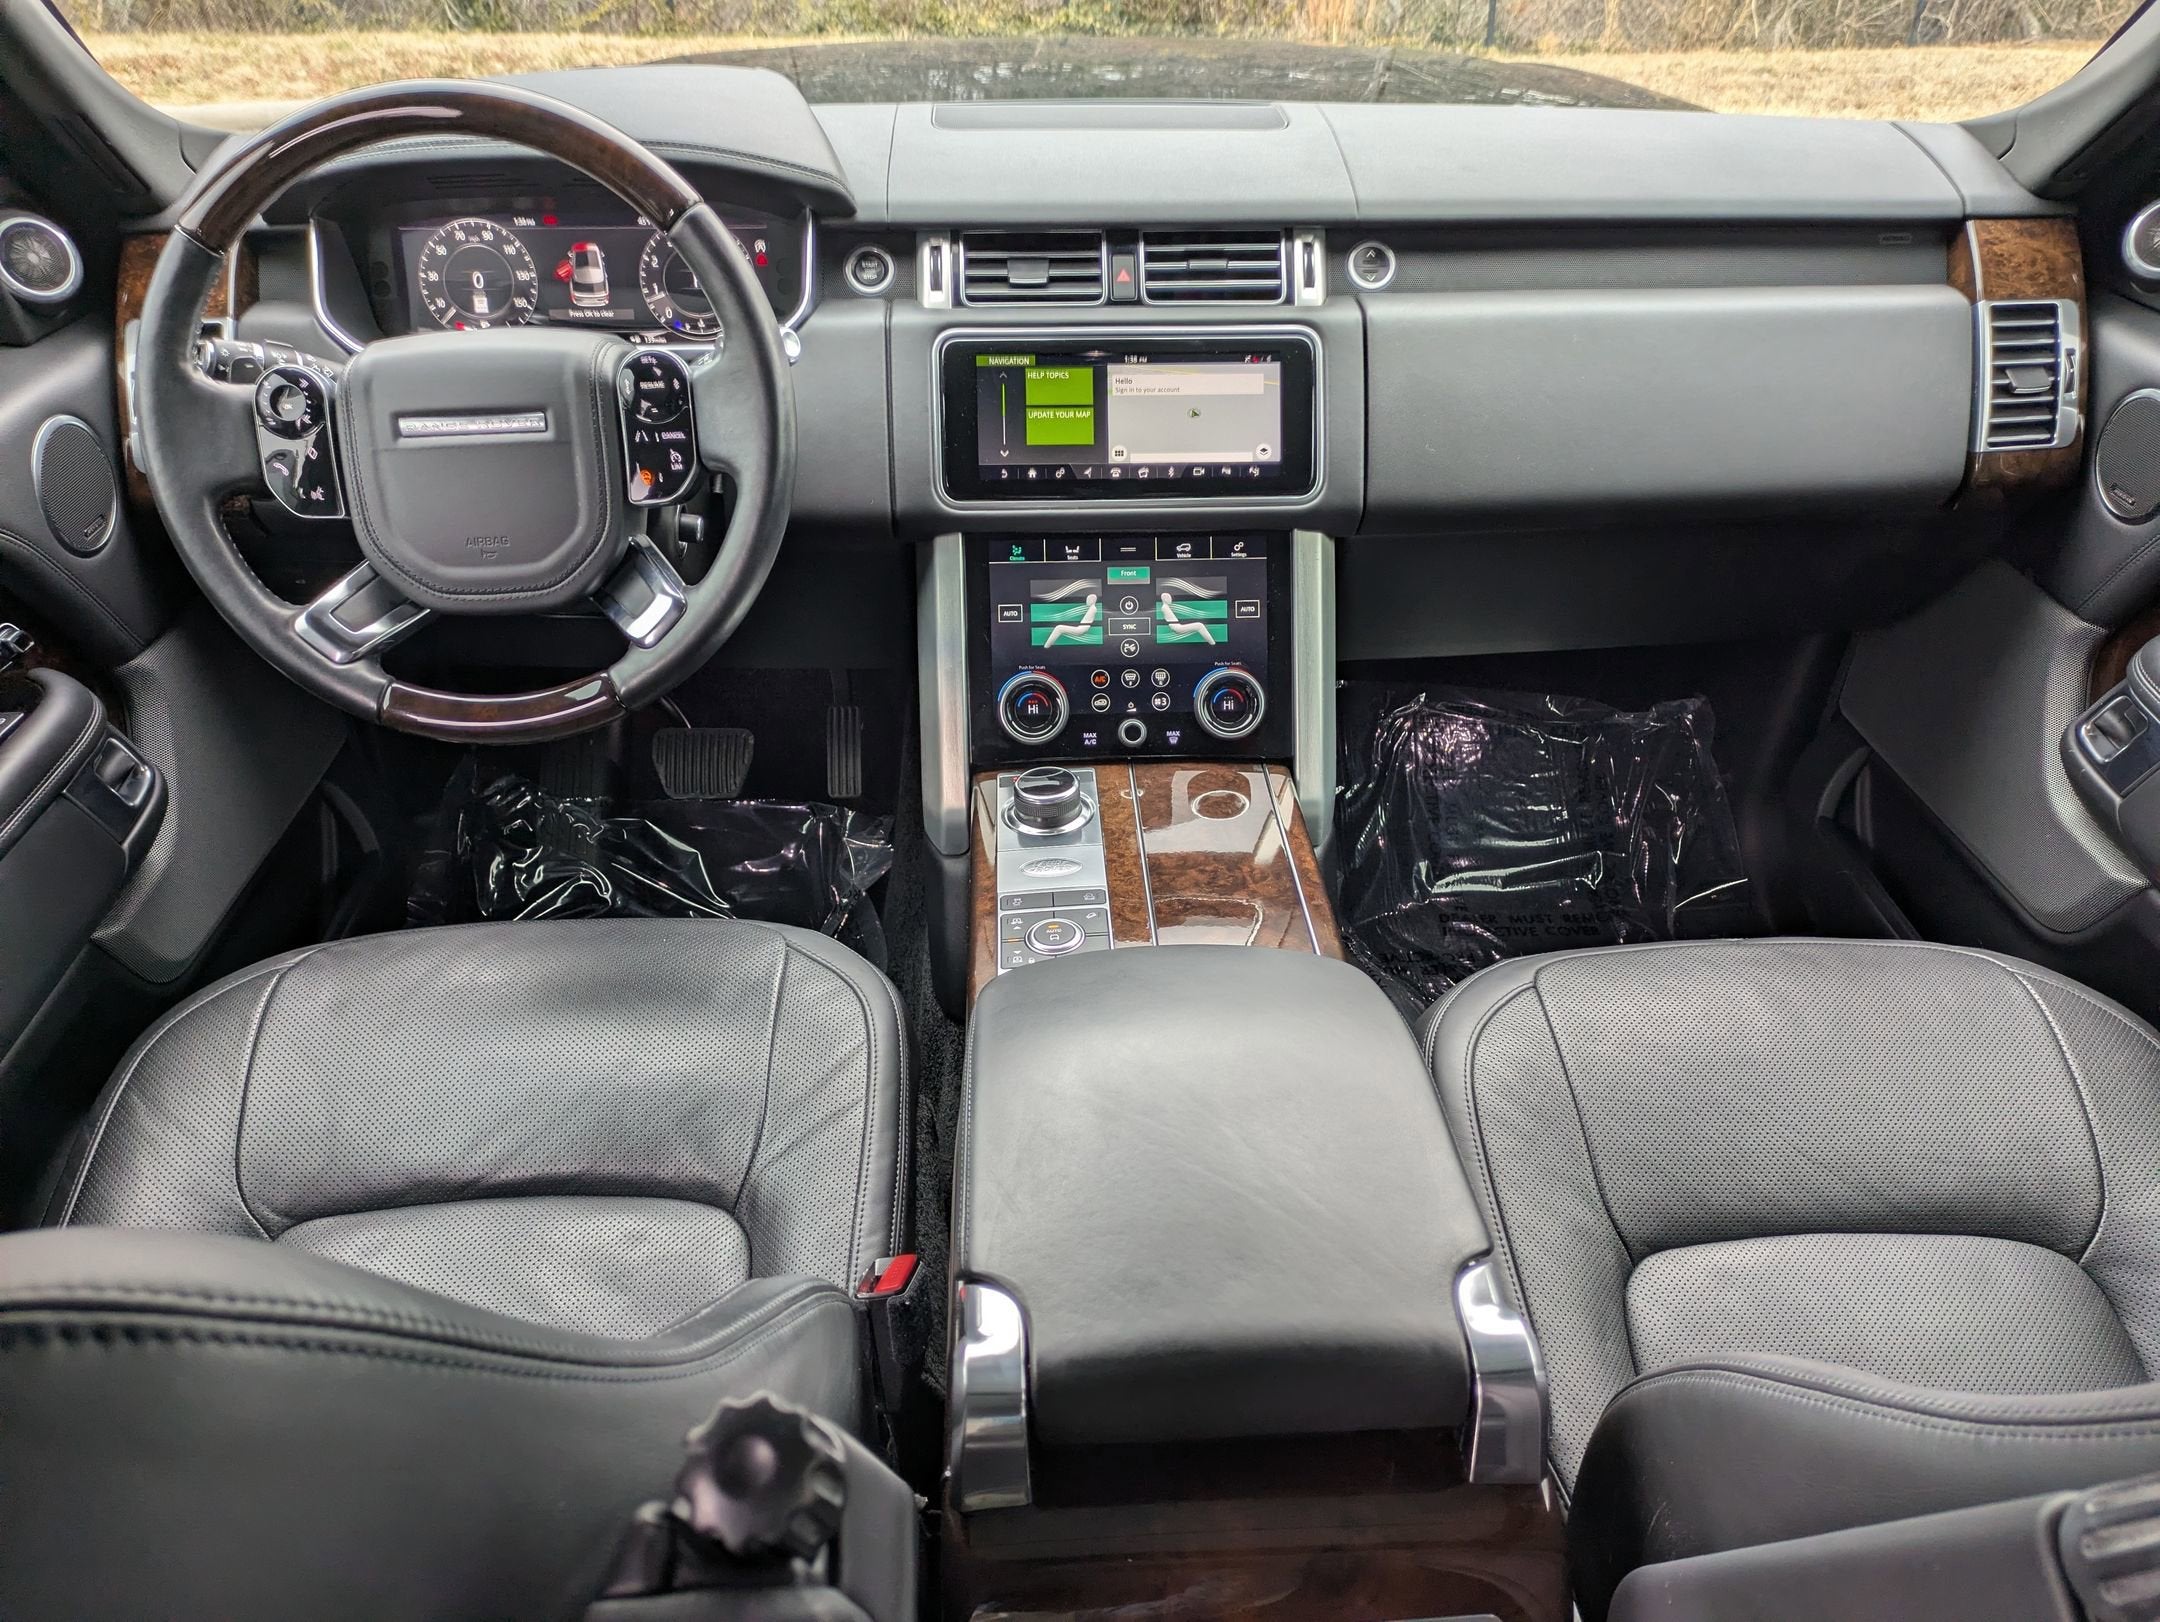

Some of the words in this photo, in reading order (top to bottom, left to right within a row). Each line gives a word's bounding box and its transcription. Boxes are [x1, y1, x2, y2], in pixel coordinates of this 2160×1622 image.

[454, 230, 466, 241] 70
[482, 230, 494, 241] 90
[435, 245, 447, 256] 50
[503, 244, 516, 255] 110
[651, 255, 659, 268] 2
[427, 271, 439, 281] 30
[472, 271, 484, 289] 0
[515, 270, 530, 281] 130
[435, 297, 446, 308] 10
[513, 297, 528, 308] 150
[665, 308, 673, 319] 0
[988, 356, 1030, 365] NAVIGATION
[1124, 354, 1138, 364] 1:38
[1027, 371, 1045, 379] HELP
[1046, 371, 1070, 379] TOPICS
[1115, 377, 1133, 385] Hello
[1115, 387, 1128, 395] Sign
[1028, 411, 1054, 419] UPDATE
[1055, 411, 1074, 419] YOUR
[1075, 411, 1091, 419] MAP
[465, 536, 511, 549] AIRBAG
[1120, 569, 1137, 577] Front
[1028, 704, 1039, 714] Hi
[1223, 699, 1234, 710] Hi
[1511, 913, 1553, 924] MUST
[1546, 926, 1601, 937] COVER
